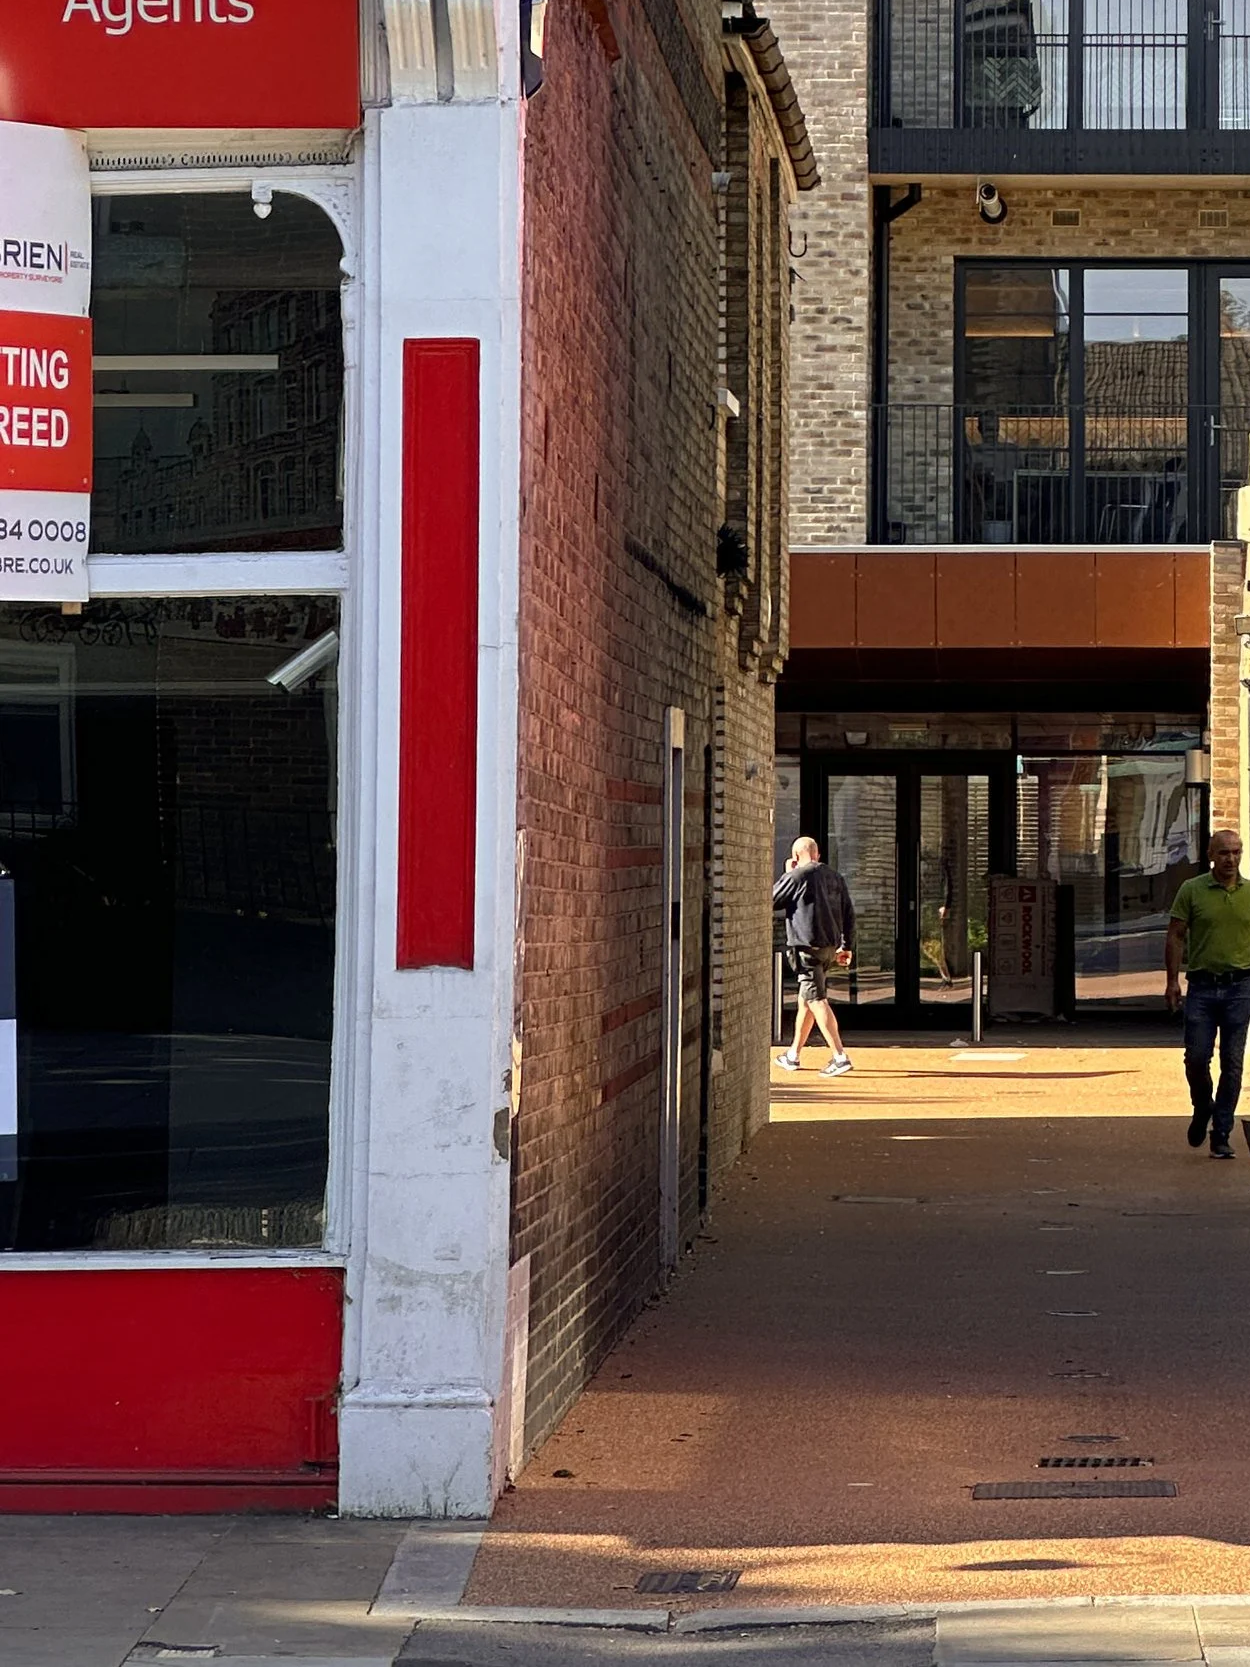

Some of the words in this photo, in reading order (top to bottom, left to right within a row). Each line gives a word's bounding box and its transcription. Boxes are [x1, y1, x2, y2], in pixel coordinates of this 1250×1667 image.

[0, 239, 62, 271] RIEN
[0, 346, 69, 389] TING
[28, 520, 86, 542] 0008
[0, 557, 73, 574] RE.CO.UK
[1022, 905, 1032, 975] ROCKWOOL
